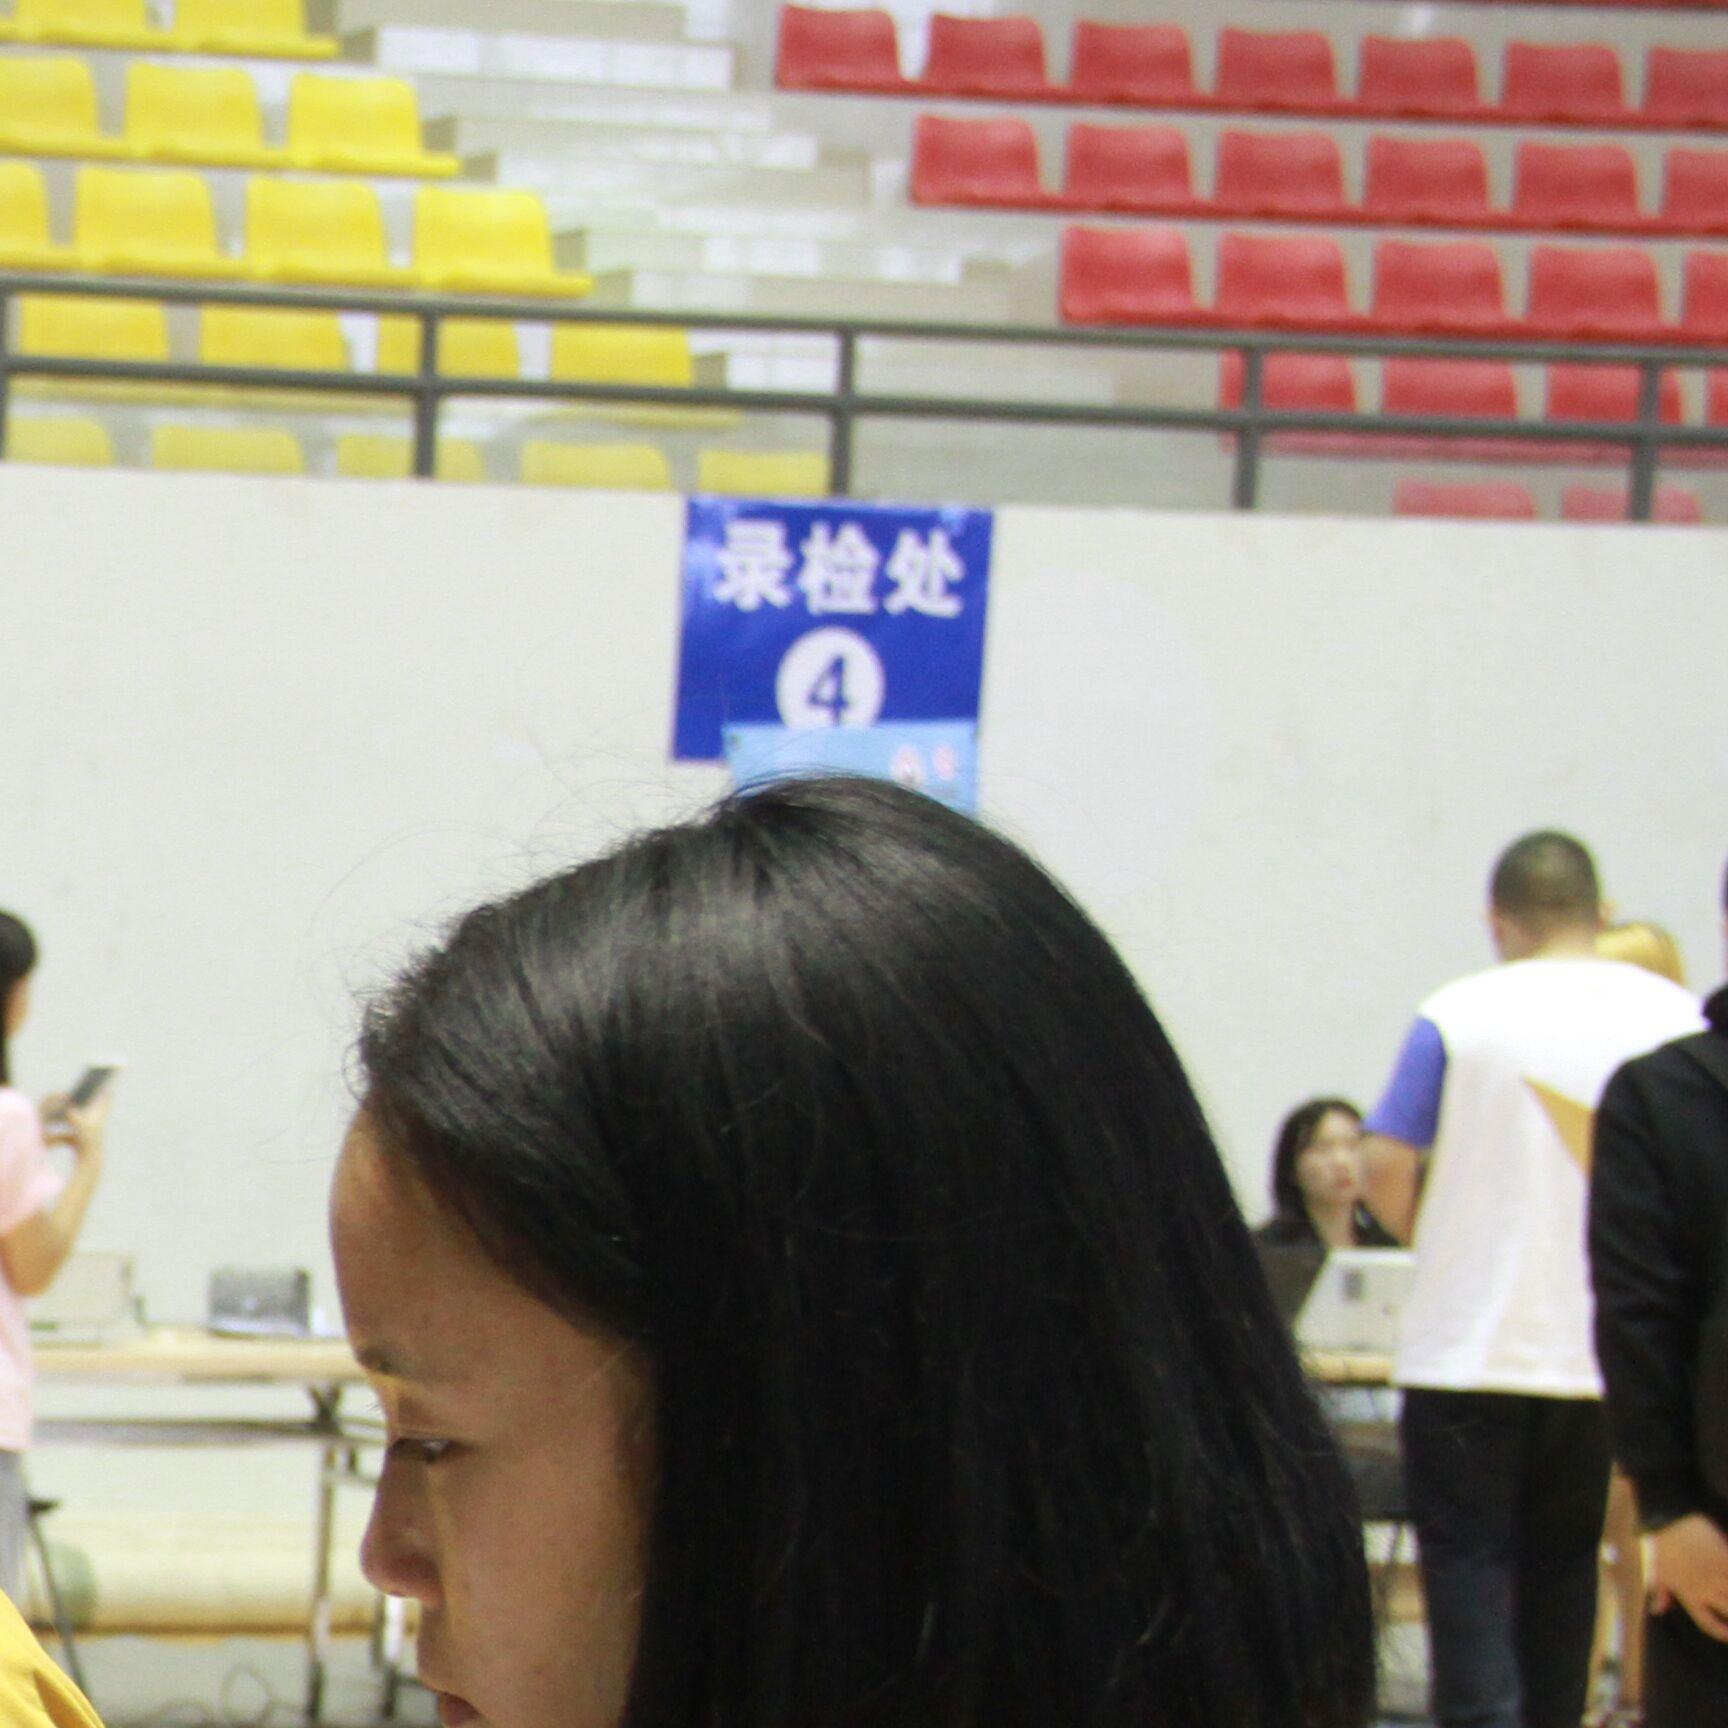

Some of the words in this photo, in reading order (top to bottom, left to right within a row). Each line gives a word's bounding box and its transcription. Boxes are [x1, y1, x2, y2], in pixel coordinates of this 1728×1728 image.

[713, 518, 966, 618] 录检处
[807, 654, 850, 727] 4
